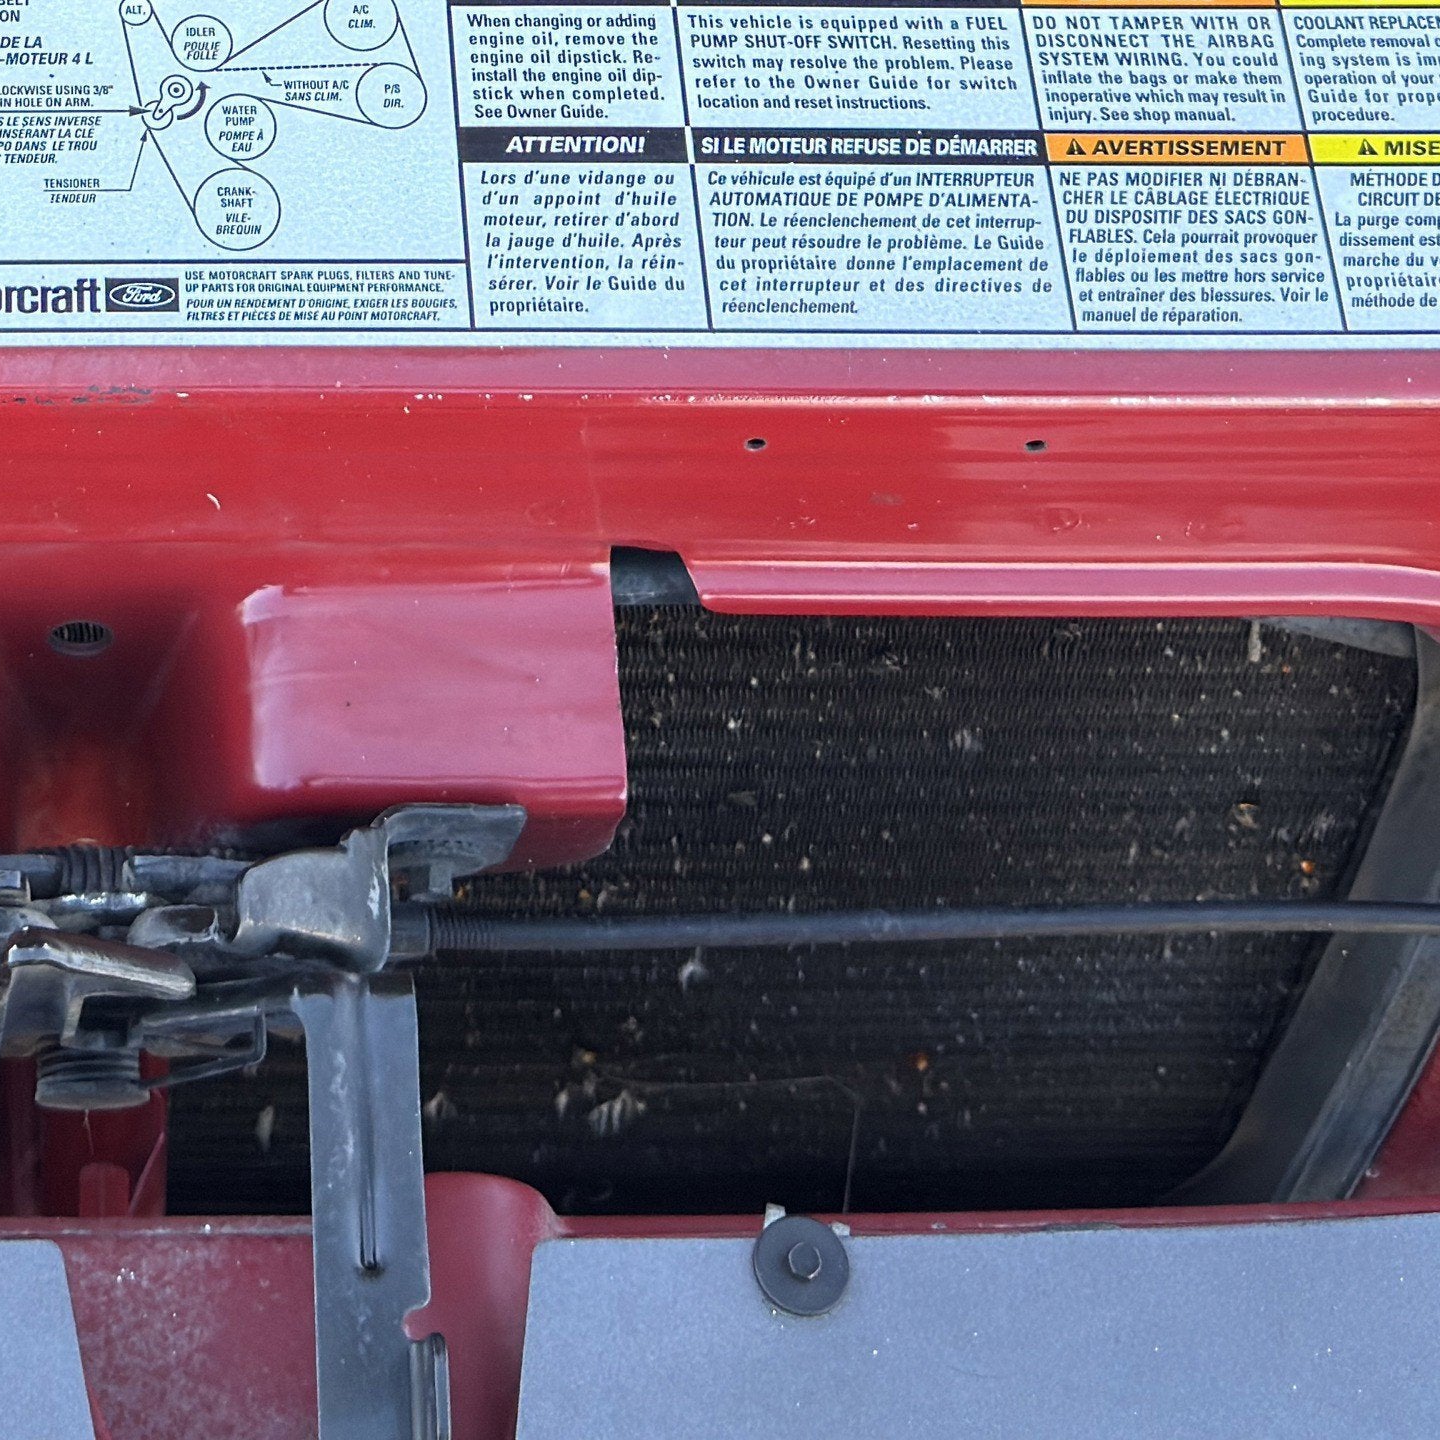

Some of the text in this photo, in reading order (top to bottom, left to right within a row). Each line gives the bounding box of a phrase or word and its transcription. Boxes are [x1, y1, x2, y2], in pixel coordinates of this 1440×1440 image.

[466, 14, 656, 30] When changing or adding
[686, 14, 1007, 32] This vehicle is equipped with a FUEL
[1293, 15, 1364, 29] COOLANT
[185, 27, 217, 38] IDLER
[505, 135, 645, 153] ATTENTION!
[700, 134, 1038, 156] SI LE MOTEUR REFUSE DE DÉMARRER
[1091, 140, 1286, 155] AVERTISSEMENT
[1384, 140, 1440, 155] MISE
[44, 178, 101, 189] TENSIONER
[121, 285, 165, 306] Ford
